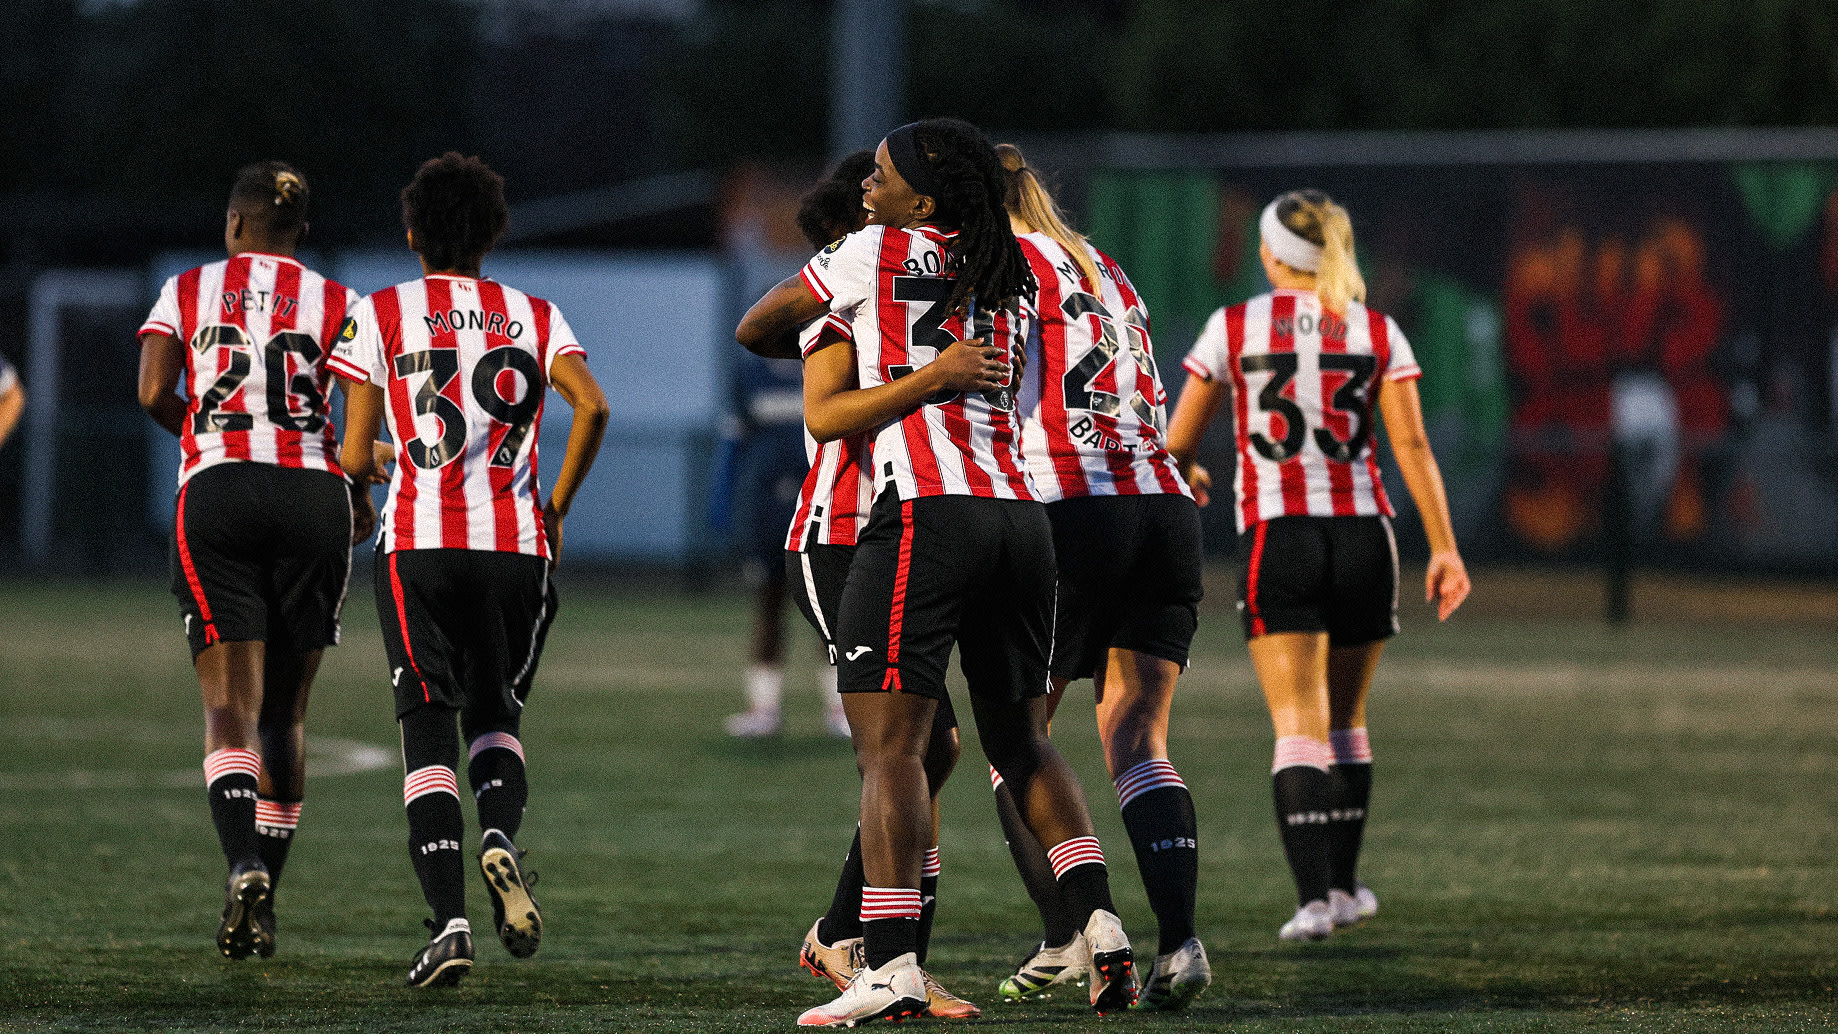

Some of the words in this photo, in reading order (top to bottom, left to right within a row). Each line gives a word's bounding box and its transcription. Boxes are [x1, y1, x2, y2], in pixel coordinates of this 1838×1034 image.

[222, 289, 299, 317] PETIT
[423, 309, 524, 340] MONRO
[1272, 311, 1348, 341] WOOD
[191, 325, 324, 434] 26
[394, 345, 543, 470] 39
[1240, 352, 1377, 462] 33
